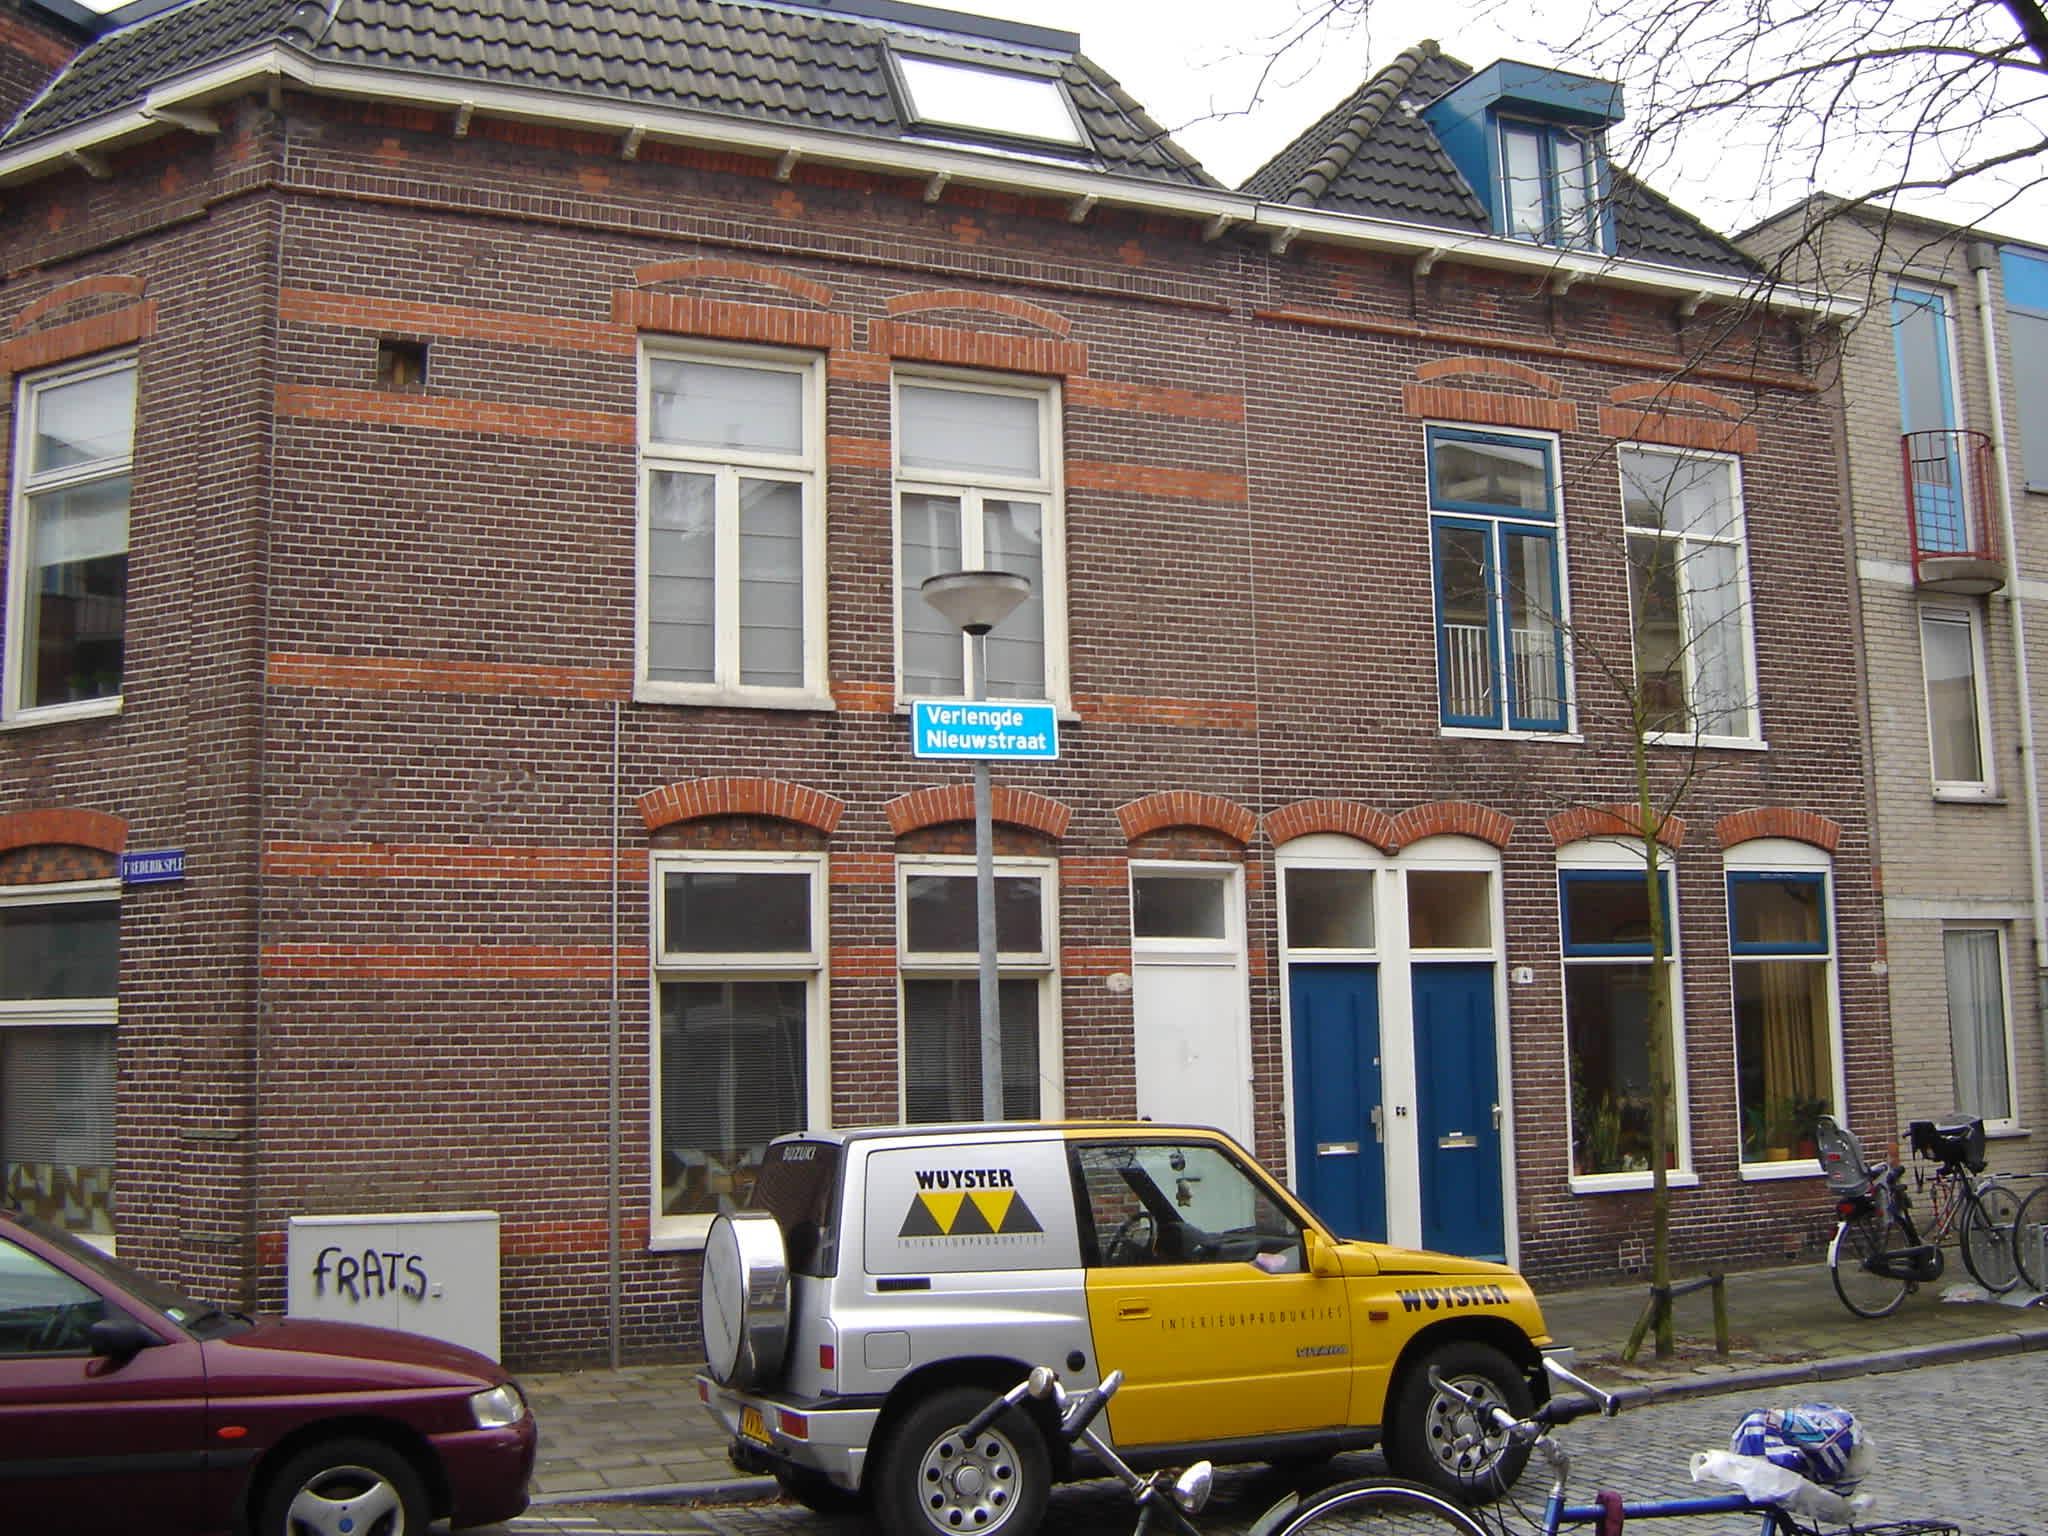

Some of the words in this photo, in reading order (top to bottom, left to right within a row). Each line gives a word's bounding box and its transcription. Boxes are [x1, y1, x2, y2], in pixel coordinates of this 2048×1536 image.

[926, 706, 1024, 731] Verlengde
[926, 730, 1047, 750] Nieuwstraat
[783, 1145, 816, 1160] SUZUKI
[915, 1168, 1014, 1190] WUYSTER
[1395, 1284, 1510, 1312] WUYSTER
